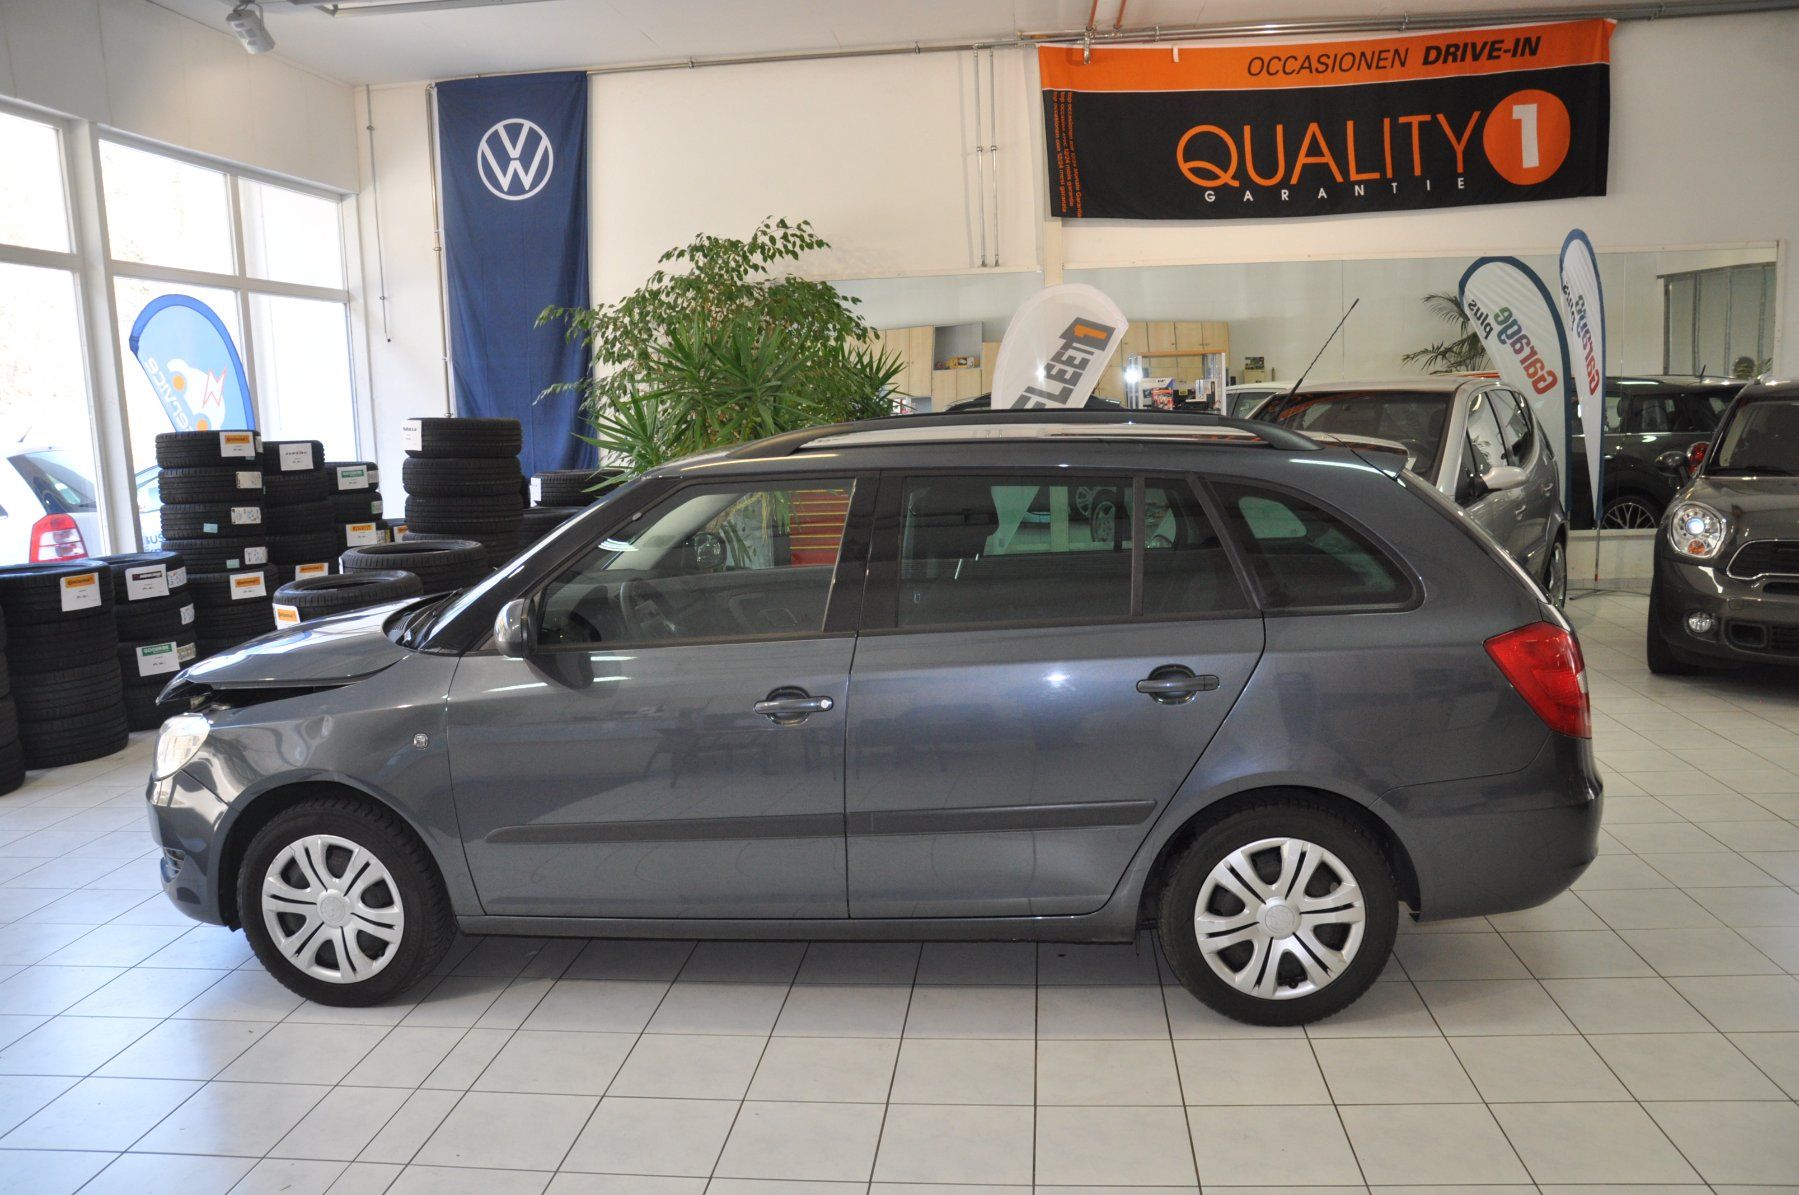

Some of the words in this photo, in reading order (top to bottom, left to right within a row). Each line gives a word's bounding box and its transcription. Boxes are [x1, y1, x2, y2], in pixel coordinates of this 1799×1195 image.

[1247, 48, 1409, 77] OCCASIONEN
[1421, 36, 1541, 66] DRIVE-IN
[1176, 111, 1481, 187] QUALITY
[1512, 104, 1540, 168] 1
[1204, 177, 1465, 202] GARANTIE
